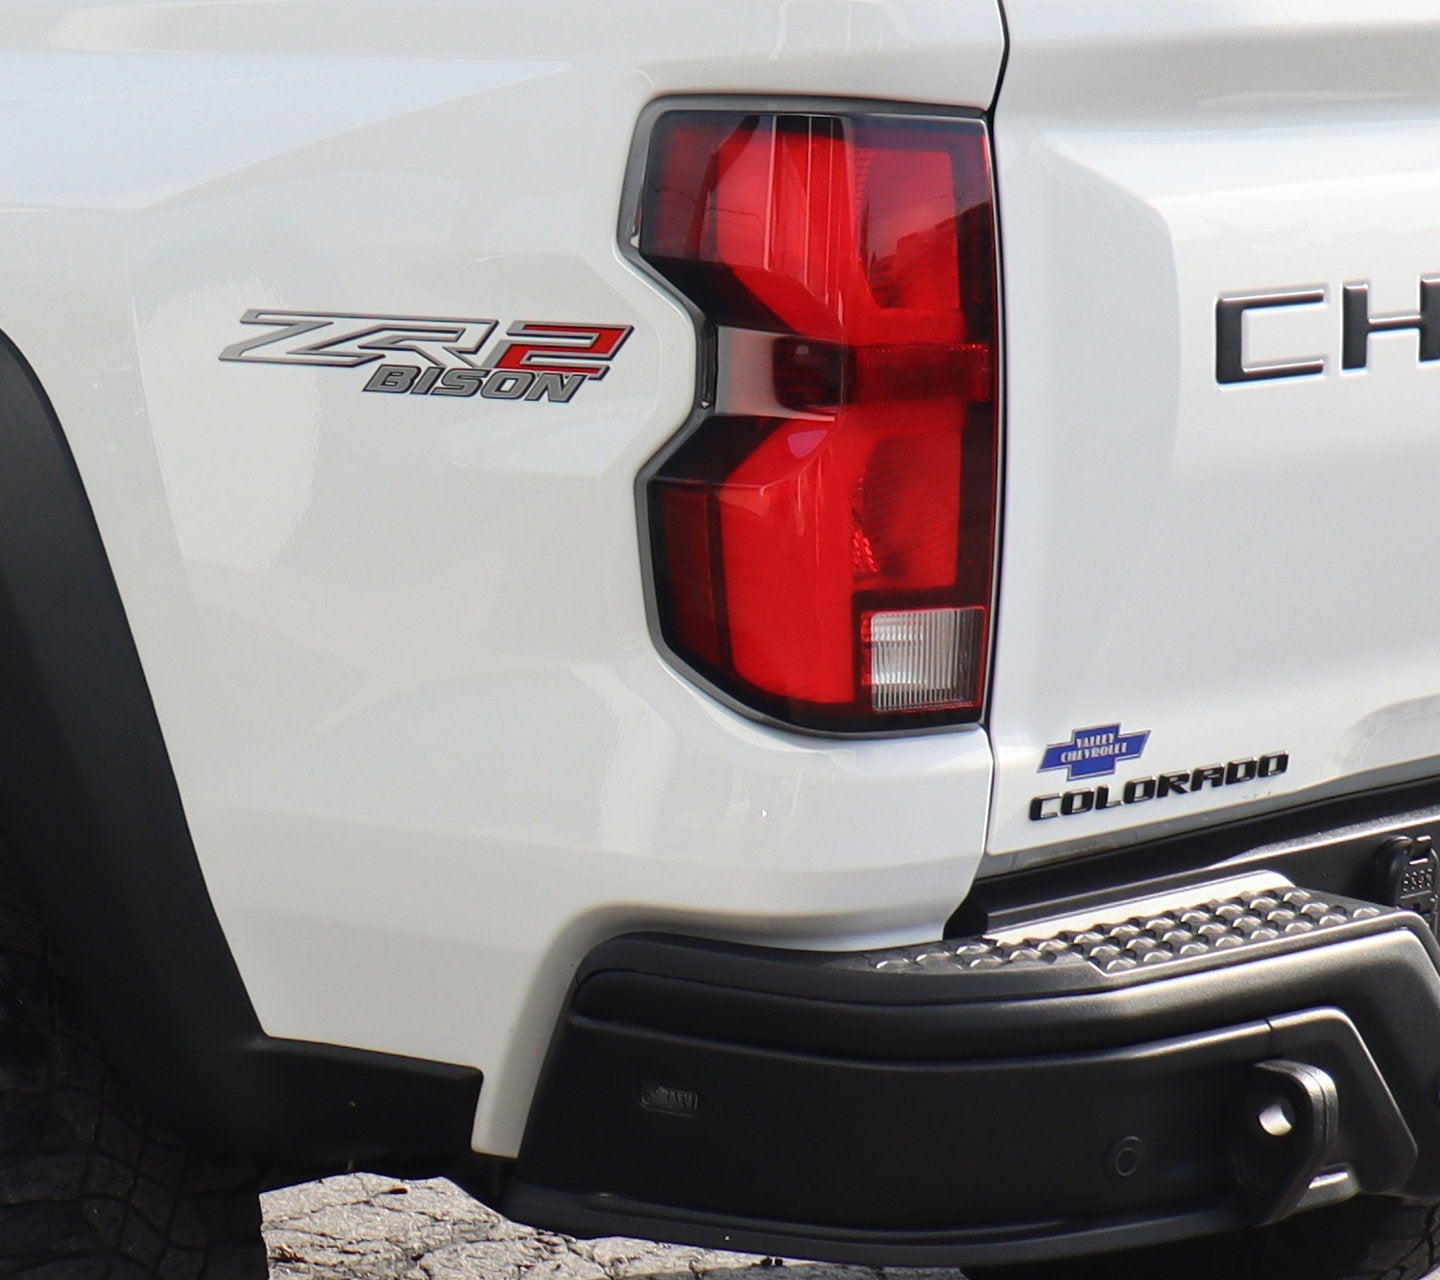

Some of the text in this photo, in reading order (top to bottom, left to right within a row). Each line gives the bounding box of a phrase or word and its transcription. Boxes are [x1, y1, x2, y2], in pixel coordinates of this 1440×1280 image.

[217, 307, 635, 382] ZR2
[361, 363, 591, 404] BISON
[1059, 741, 1129, 764] CHEVROLET
[1075, 732, 1118, 750] VALLEY
[1028, 748, 1290, 822] COLORADO
